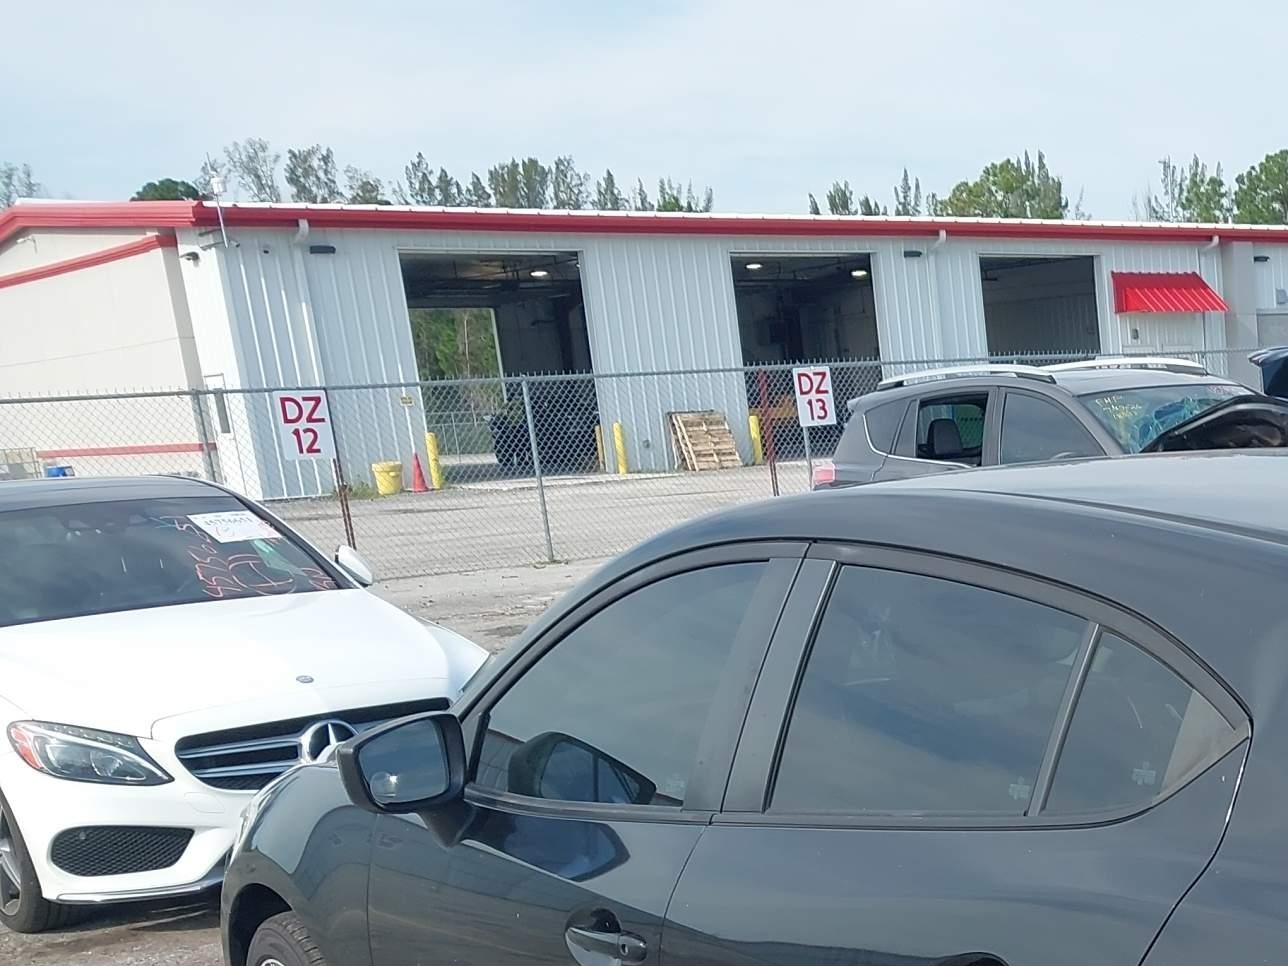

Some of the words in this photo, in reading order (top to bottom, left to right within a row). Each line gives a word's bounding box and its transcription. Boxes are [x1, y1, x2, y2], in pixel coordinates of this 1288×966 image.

[797, 371, 829, 396] DZ
[279, 396, 326, 424] DZ
[806, 398, 828, 421] 13
[291, 427, 321, 454] 12
